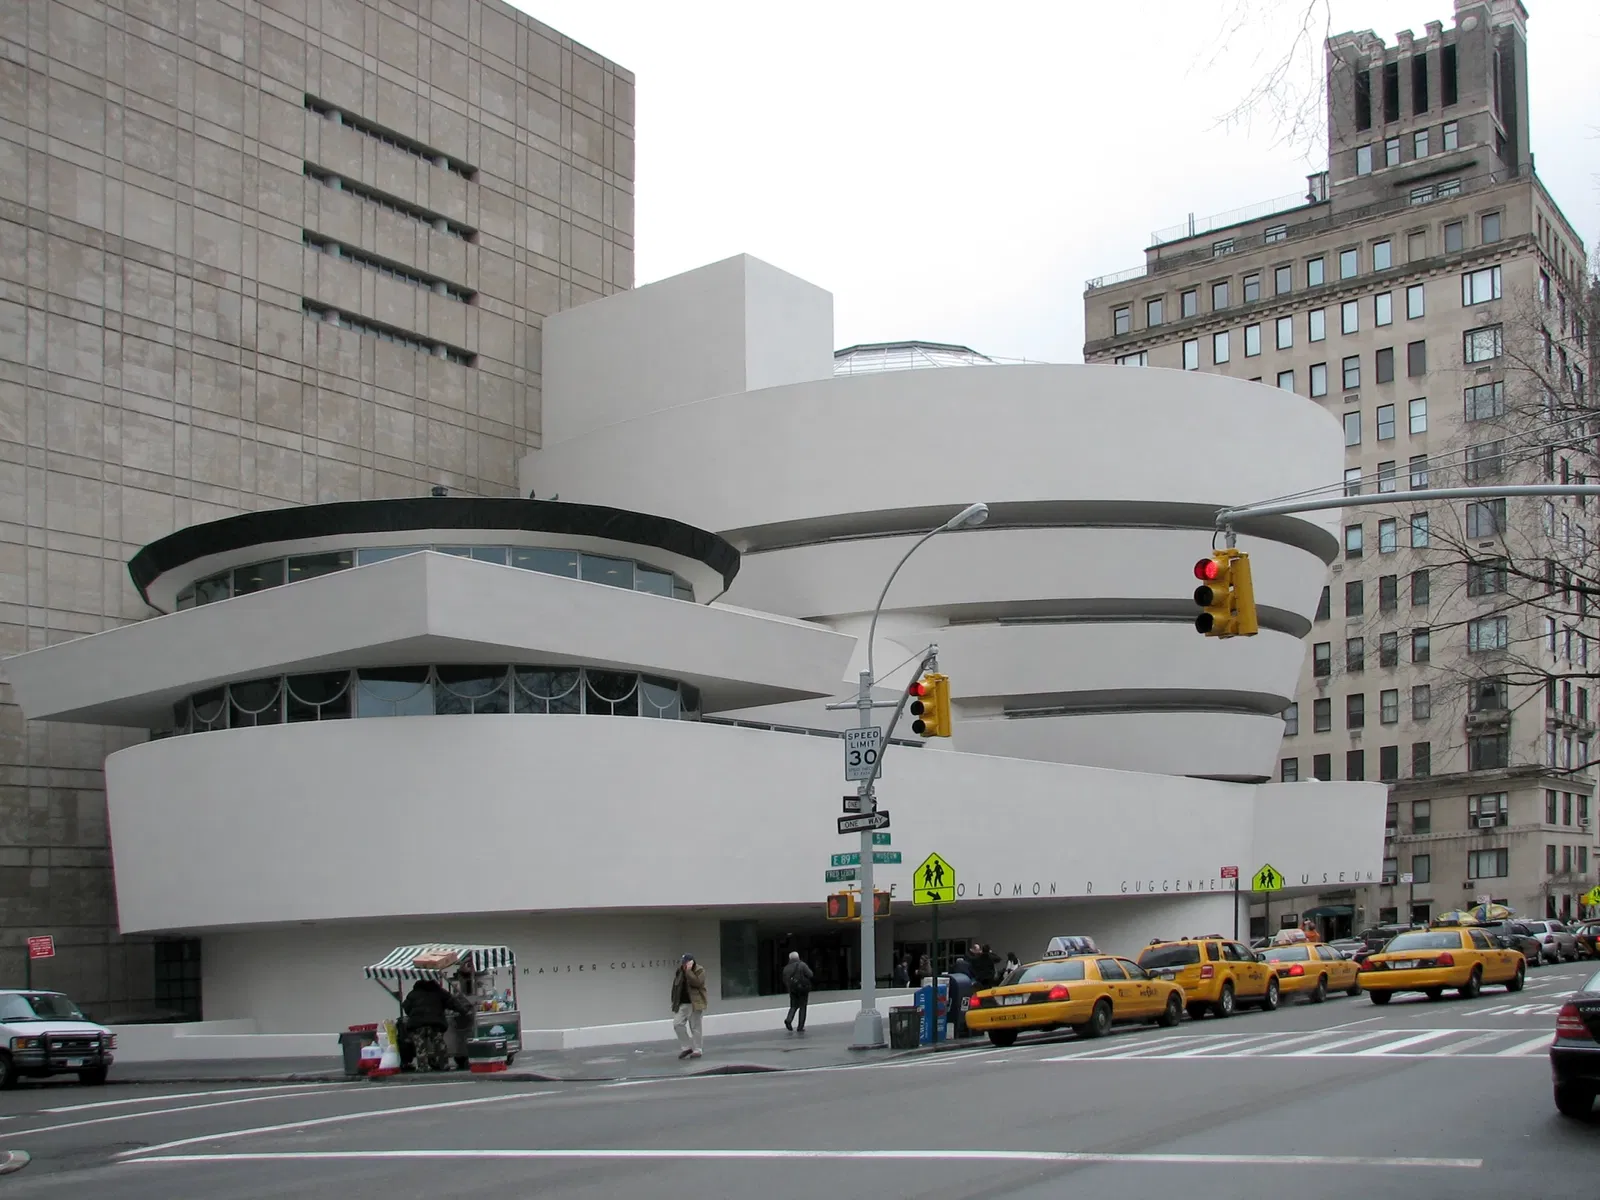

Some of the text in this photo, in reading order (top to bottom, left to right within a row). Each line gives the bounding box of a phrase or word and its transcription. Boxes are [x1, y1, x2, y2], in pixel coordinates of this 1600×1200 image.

[848, 731, 879, 740] SPEED
[851, 740, 875, 748] LIMIT
[849, 749, 877, 766] 30
[868, 816, 883, 825] WAY
[833, 856, 839, 866] E
[840, 854, 851, 865] 89
[957, 882, 1057, 897] OLOMON
[1086, 882, 1093, 894] R
